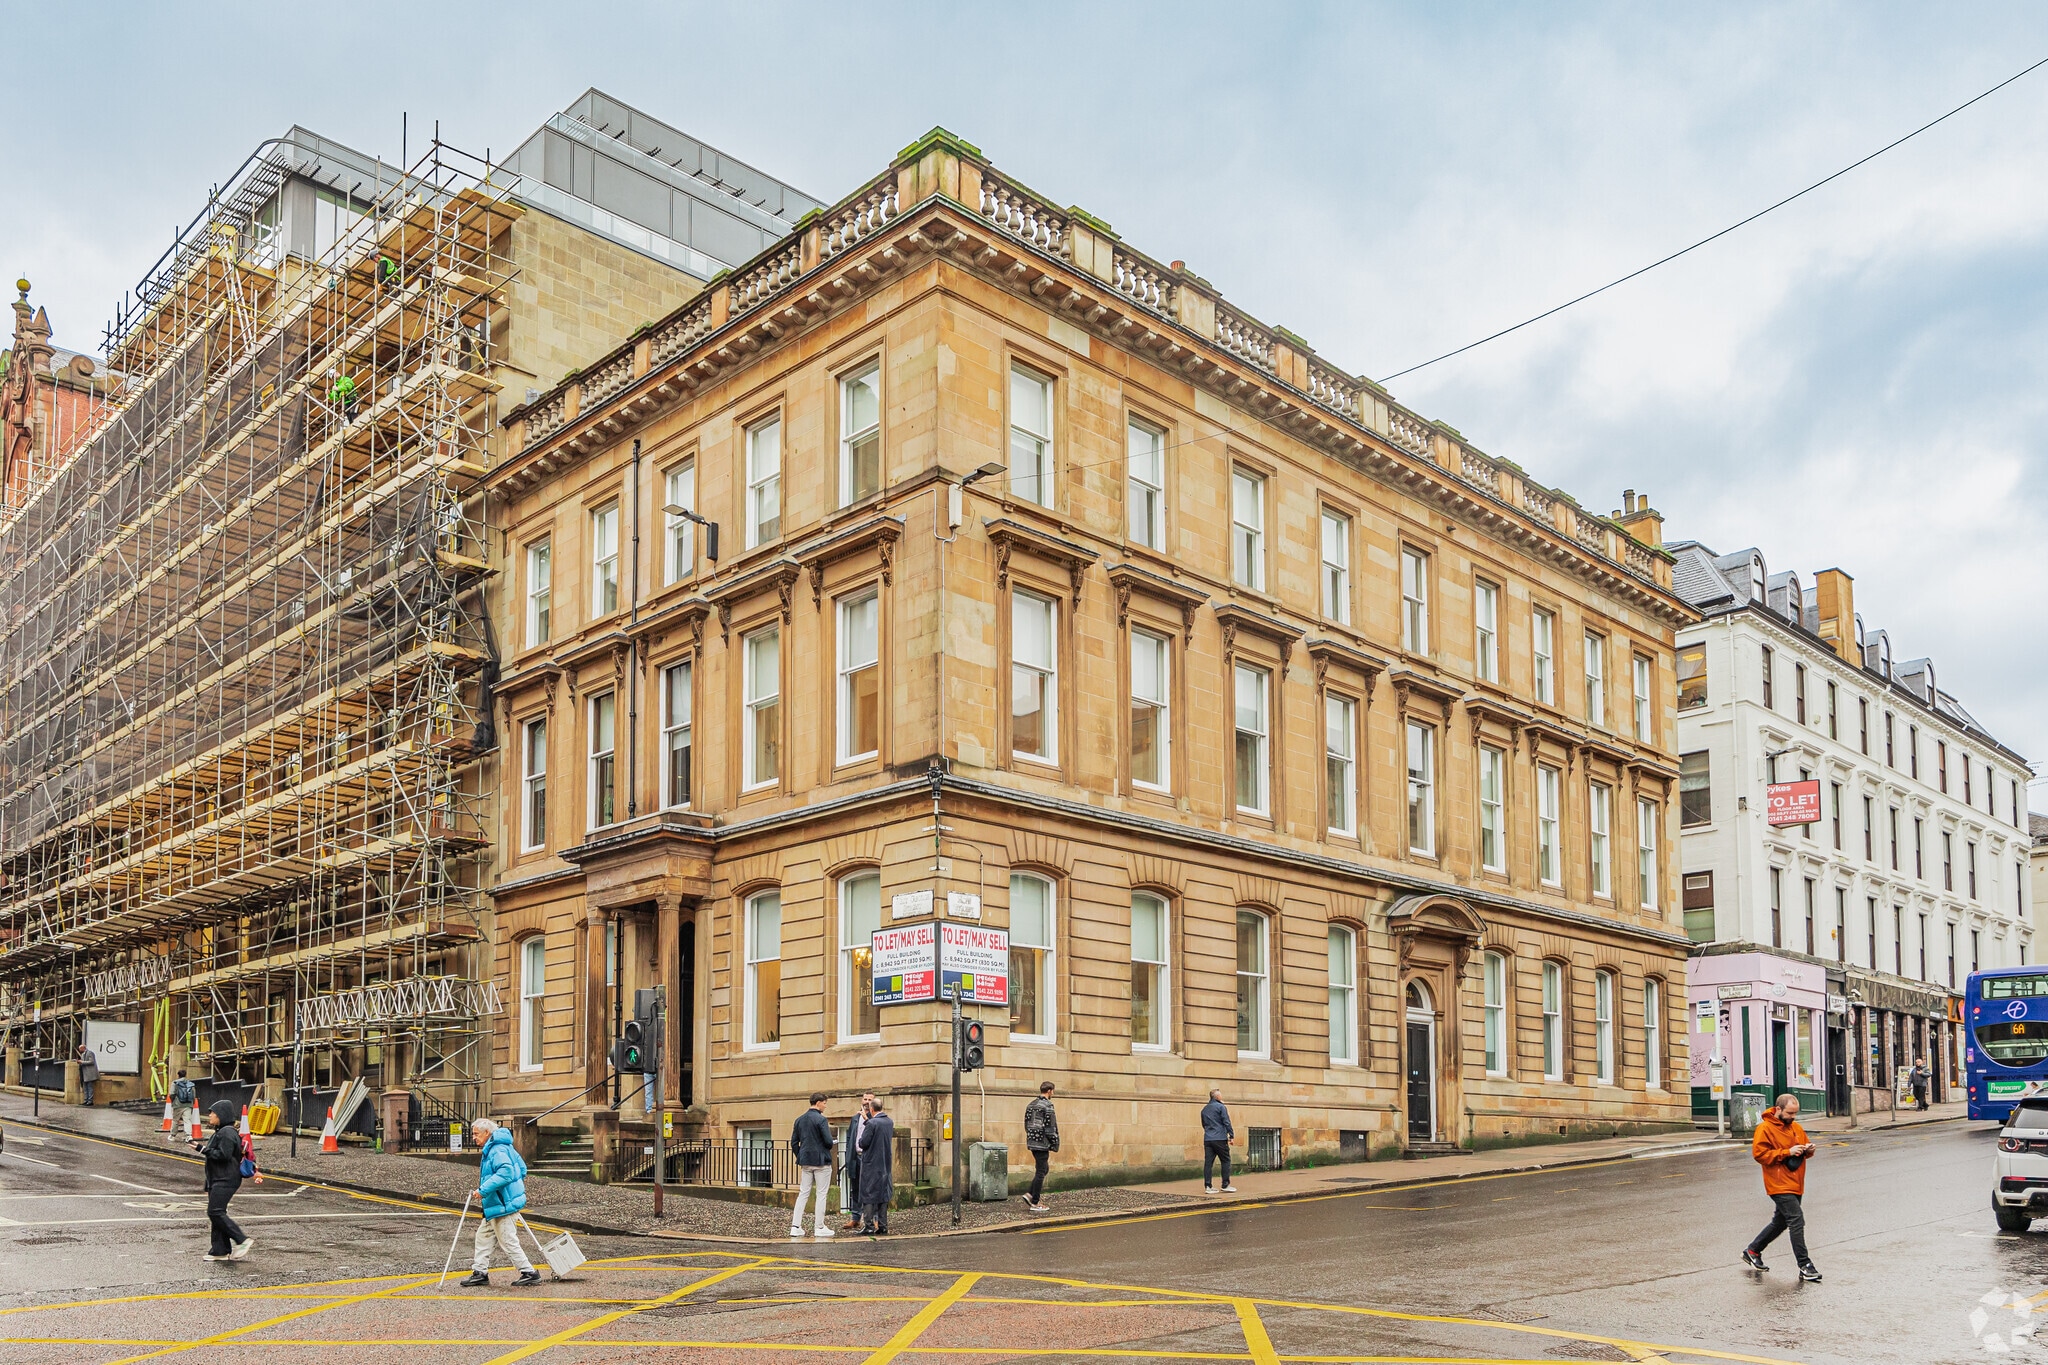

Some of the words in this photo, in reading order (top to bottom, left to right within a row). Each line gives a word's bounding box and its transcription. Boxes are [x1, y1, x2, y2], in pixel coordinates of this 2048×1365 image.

[1767, 797, 1785, 808] TO
[1790, 794, 1816, 806] LET
[874, 936, 884, 951] TO
[885, 930, 916, 951] LET/MAY
[917, 928, 934, 945] SELL
[942, 927, 953, 944] TO
[954, 929, 988, 949] LET/MAY
[989, 933, 1007, 951] SELL
[970, 951, 993, 959] BUILDING
[2013, 1023, 2025, 1034] 6A
[1990, 1082, 2022, 1094] Pregnacare
